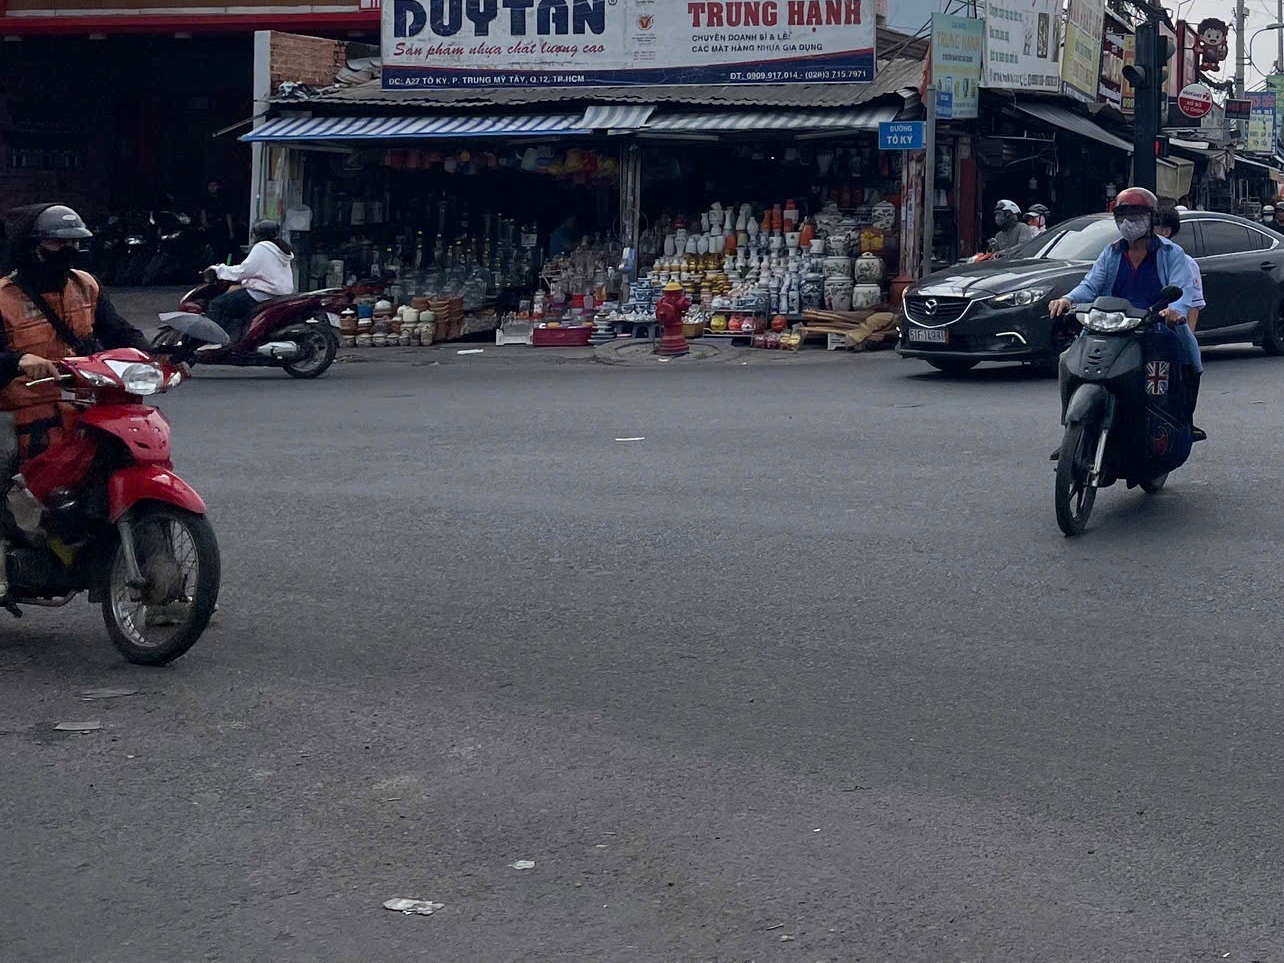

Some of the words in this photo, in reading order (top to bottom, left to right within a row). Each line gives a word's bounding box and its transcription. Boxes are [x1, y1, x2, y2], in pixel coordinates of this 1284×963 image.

[688, 1, 778, 27] TRUNG
[788, 0, 862, 33] HẠNH
[692, 33, 726, 42] CHUYÊN
[394, 42, 423, 56] Sản
[469, 41, 502, 58] nhựa
[507, 41, 537, 54] chất
[582, 44, 606, 53] cao
[731, 43, 755, 52] HÀNG
[799, 43, 823, 52] DỤNG
[405, 77, 420, 85] A27
[422, 75, 434, 84] TÔ
[462, 76, 491, 84] TRUNG
[494, 75, 506, 84] MỸ
[509, 75, 528, 84] TÂY,
[890, 123, 912, 132] ĐƯỜNG
[887, 134, 898, 144] TÔ
[900, 133, 913, 144] KÝ
